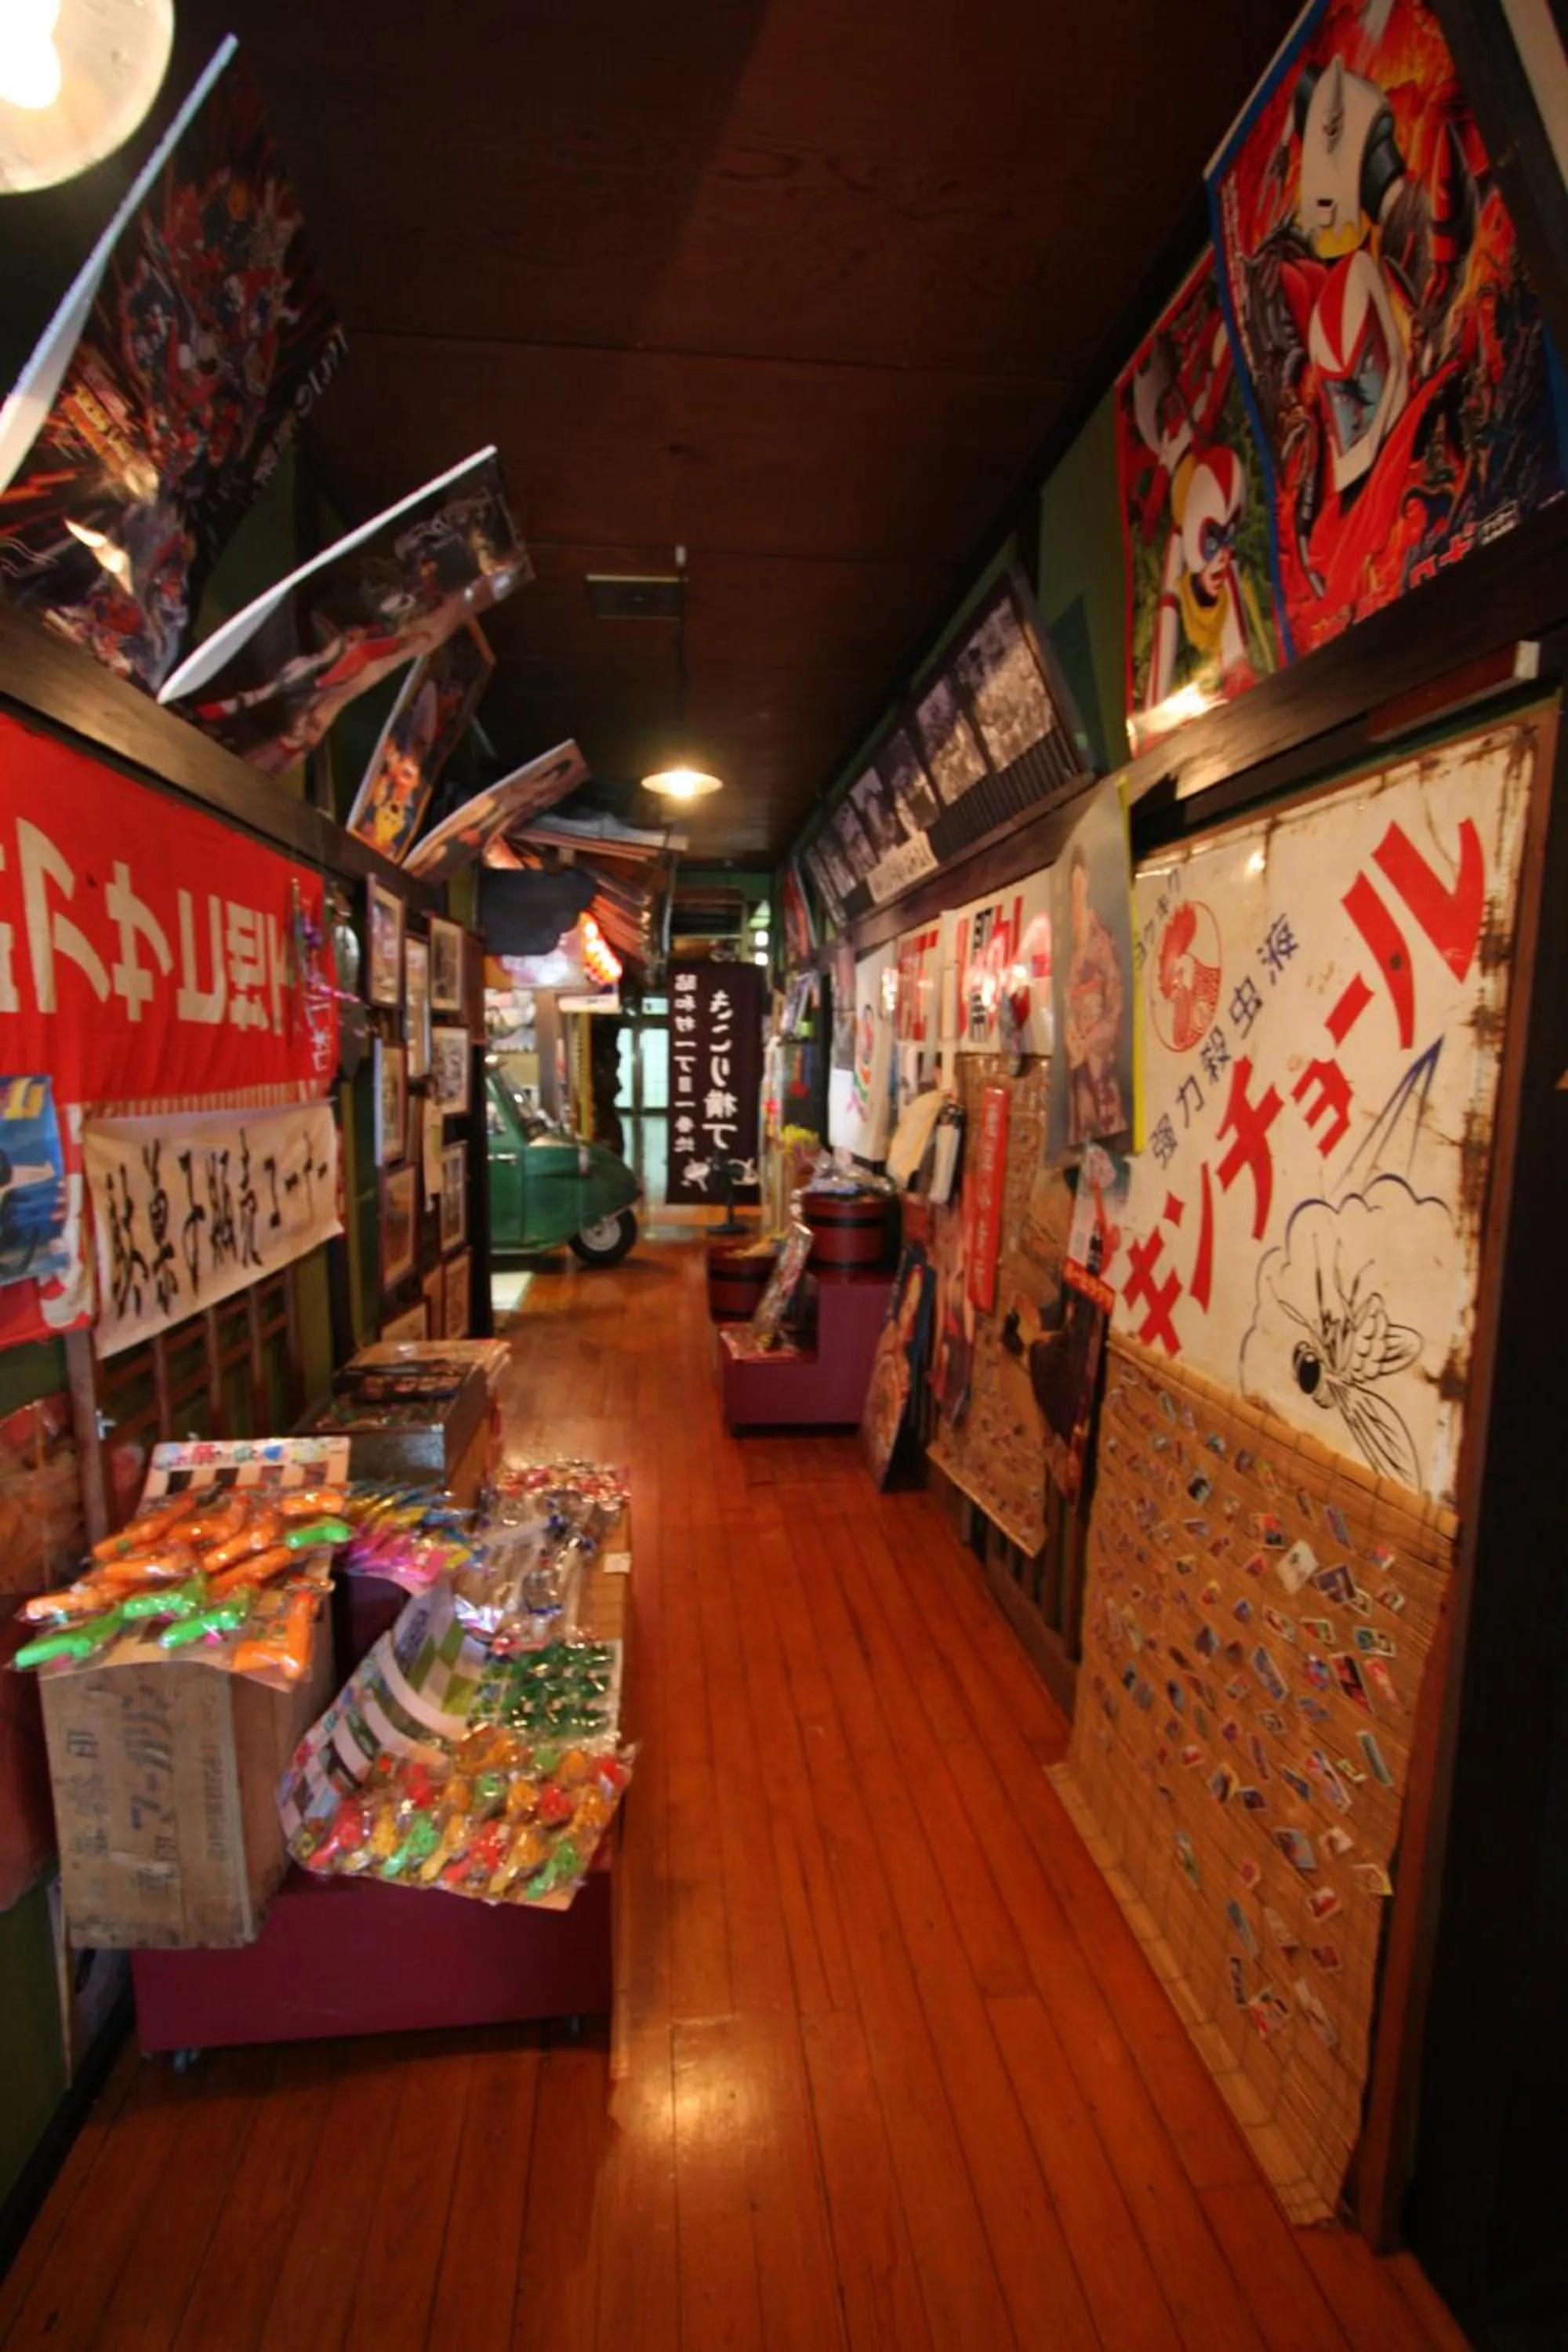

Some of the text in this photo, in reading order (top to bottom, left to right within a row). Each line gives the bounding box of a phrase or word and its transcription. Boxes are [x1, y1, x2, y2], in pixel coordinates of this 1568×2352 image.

[1122, 818, 1485, 1357] キンチョール
